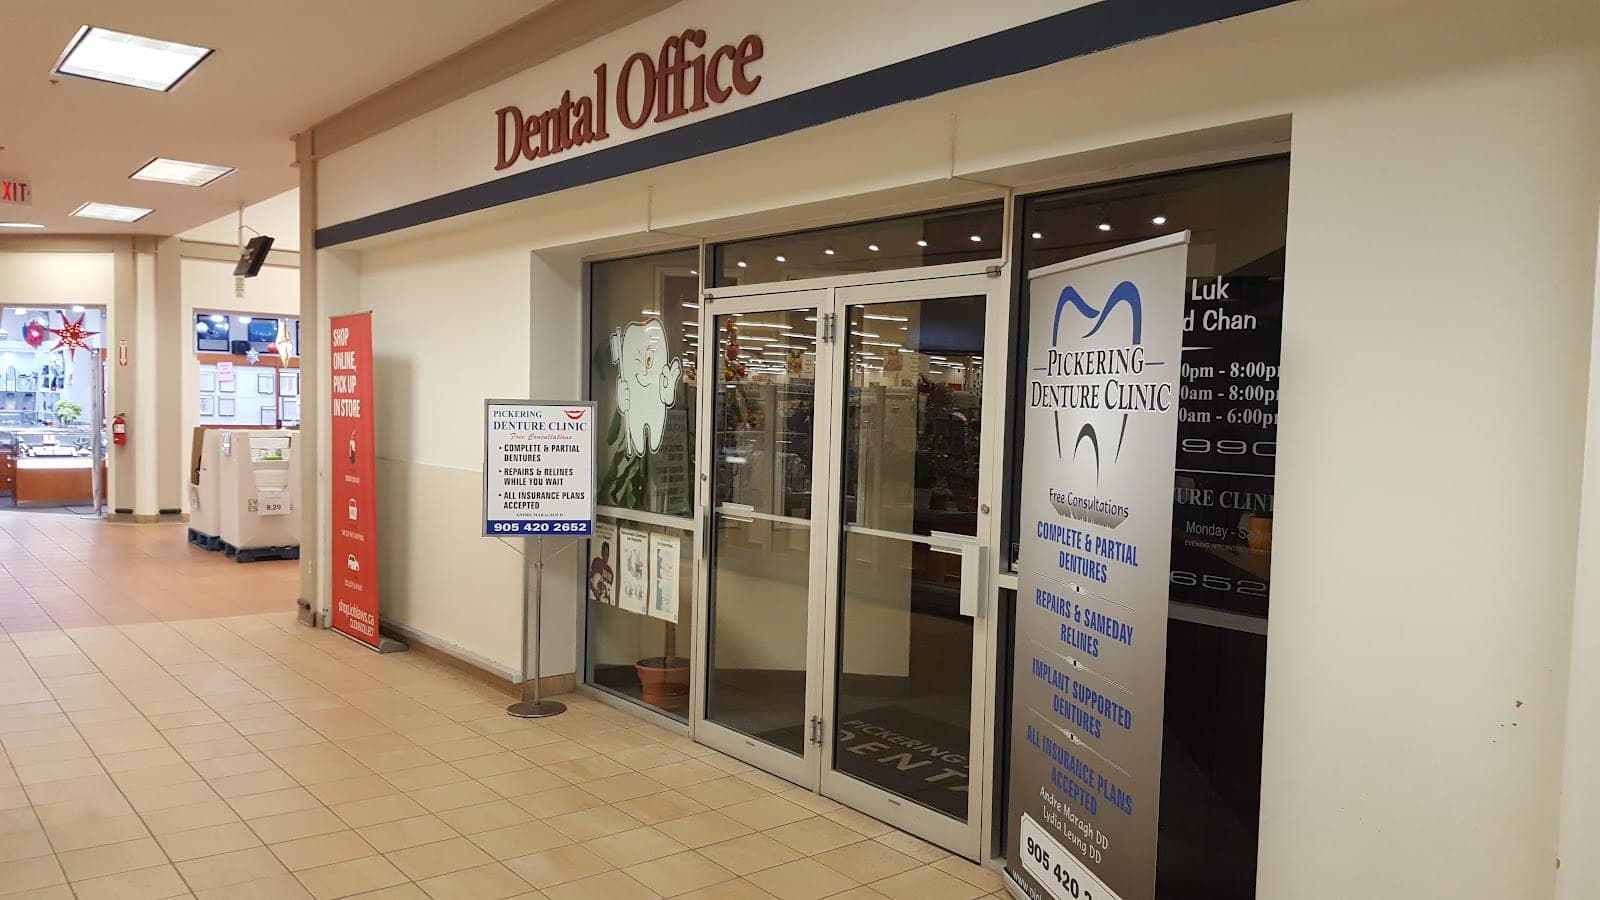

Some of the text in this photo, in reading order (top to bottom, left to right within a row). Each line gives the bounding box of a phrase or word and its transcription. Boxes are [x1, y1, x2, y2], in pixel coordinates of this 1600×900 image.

[494, 29, 763, 171] Dental Office
[3, 181, 27, 202] XIT
[1192, 275, 1230, 300] Luk
[1203, 308, 1257, 332] Chan
[333, 328, 349, 346] SHOP
[333, 351, 356, 371] ONLINE,
[1047, 347, 1144, 377] PICKERING
[333, 375, 357, 393] PICK UP
[1031, 379, 1171, 412] DENTURE CLINIC
[333, 399, 360, 417] IN STORE
[493, 410, 542, 418] PICKERING
[493, 421, 587, 431] DENTURE CLINIC
[528, 432, 572, 440] Consultations
[504, 444, 580, 453] COMPLETE & PARTIAL
[504, 454, 541, 462] DENTURES
[504, 468, 573, 476] REPAIRS & RELINES
[545, 478, 563, 486] WAIT
[504, 491, 516, 499] ALL
[562, 492, 585, 500] PLANS
[1049, 488, 1129, 518] Free Consultations
[1174, 487, 1214, 507] URE
[493, 523, 520, 532] 905
[523, 523, 549, 532] 420
[553, 523, 587, 532] 2652
[1185, 520, 1228, 540] Monday
[1037, 520, 1138, 567] COMPLETE & PARTIAL
[1059, 550, 1107, 584] DENTURES
[1036, 588, 1134, 646] REPAIRS & SAMEDAY
[1060, 623, 1099, 658] RELINES
[1032, 657, 1132, 731] IMPLANT SUPPORTED
[1053, 694, 1102, 740] DENTURES
[843, 720, 966, 763] PICKERING
[1026, 725, 1133, 816] ALL INSURANCE PLANS
[1051, 767, 1097, 816] ACCEPTED
[1039, 786, 1109, 850] Andre Maragh DD
[1043, 806, 1102, 864] Lydia Leung DD
[1027, 837, 1080, 899] 905 420
